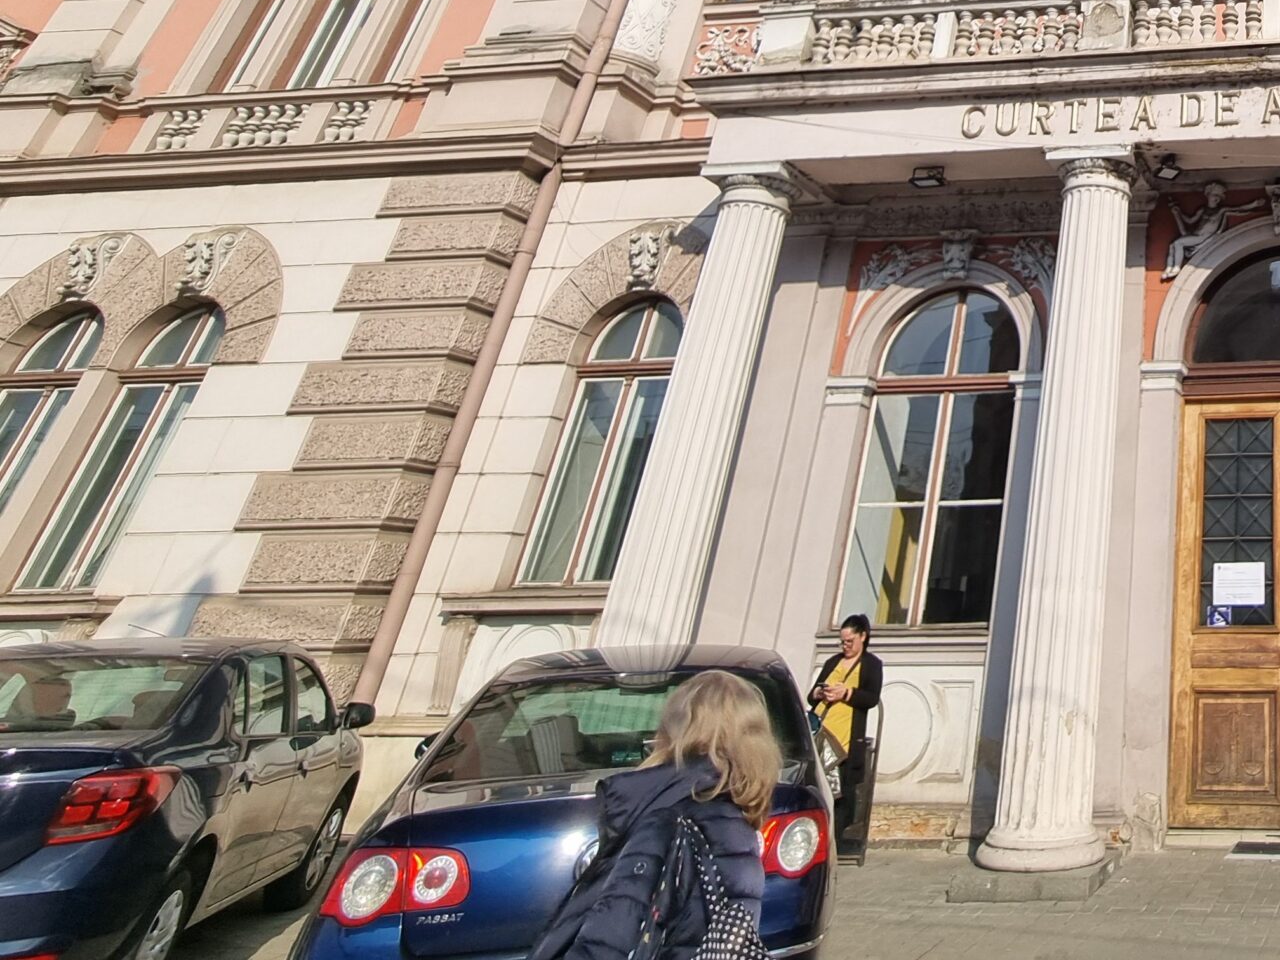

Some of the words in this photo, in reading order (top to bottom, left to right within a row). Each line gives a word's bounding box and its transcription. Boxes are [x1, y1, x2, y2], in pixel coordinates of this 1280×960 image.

[961, 95, 1157, 139] CURTEA
[1179, 90, 1241, 128] DE
[416, 912, 464, 925] PASSAT
